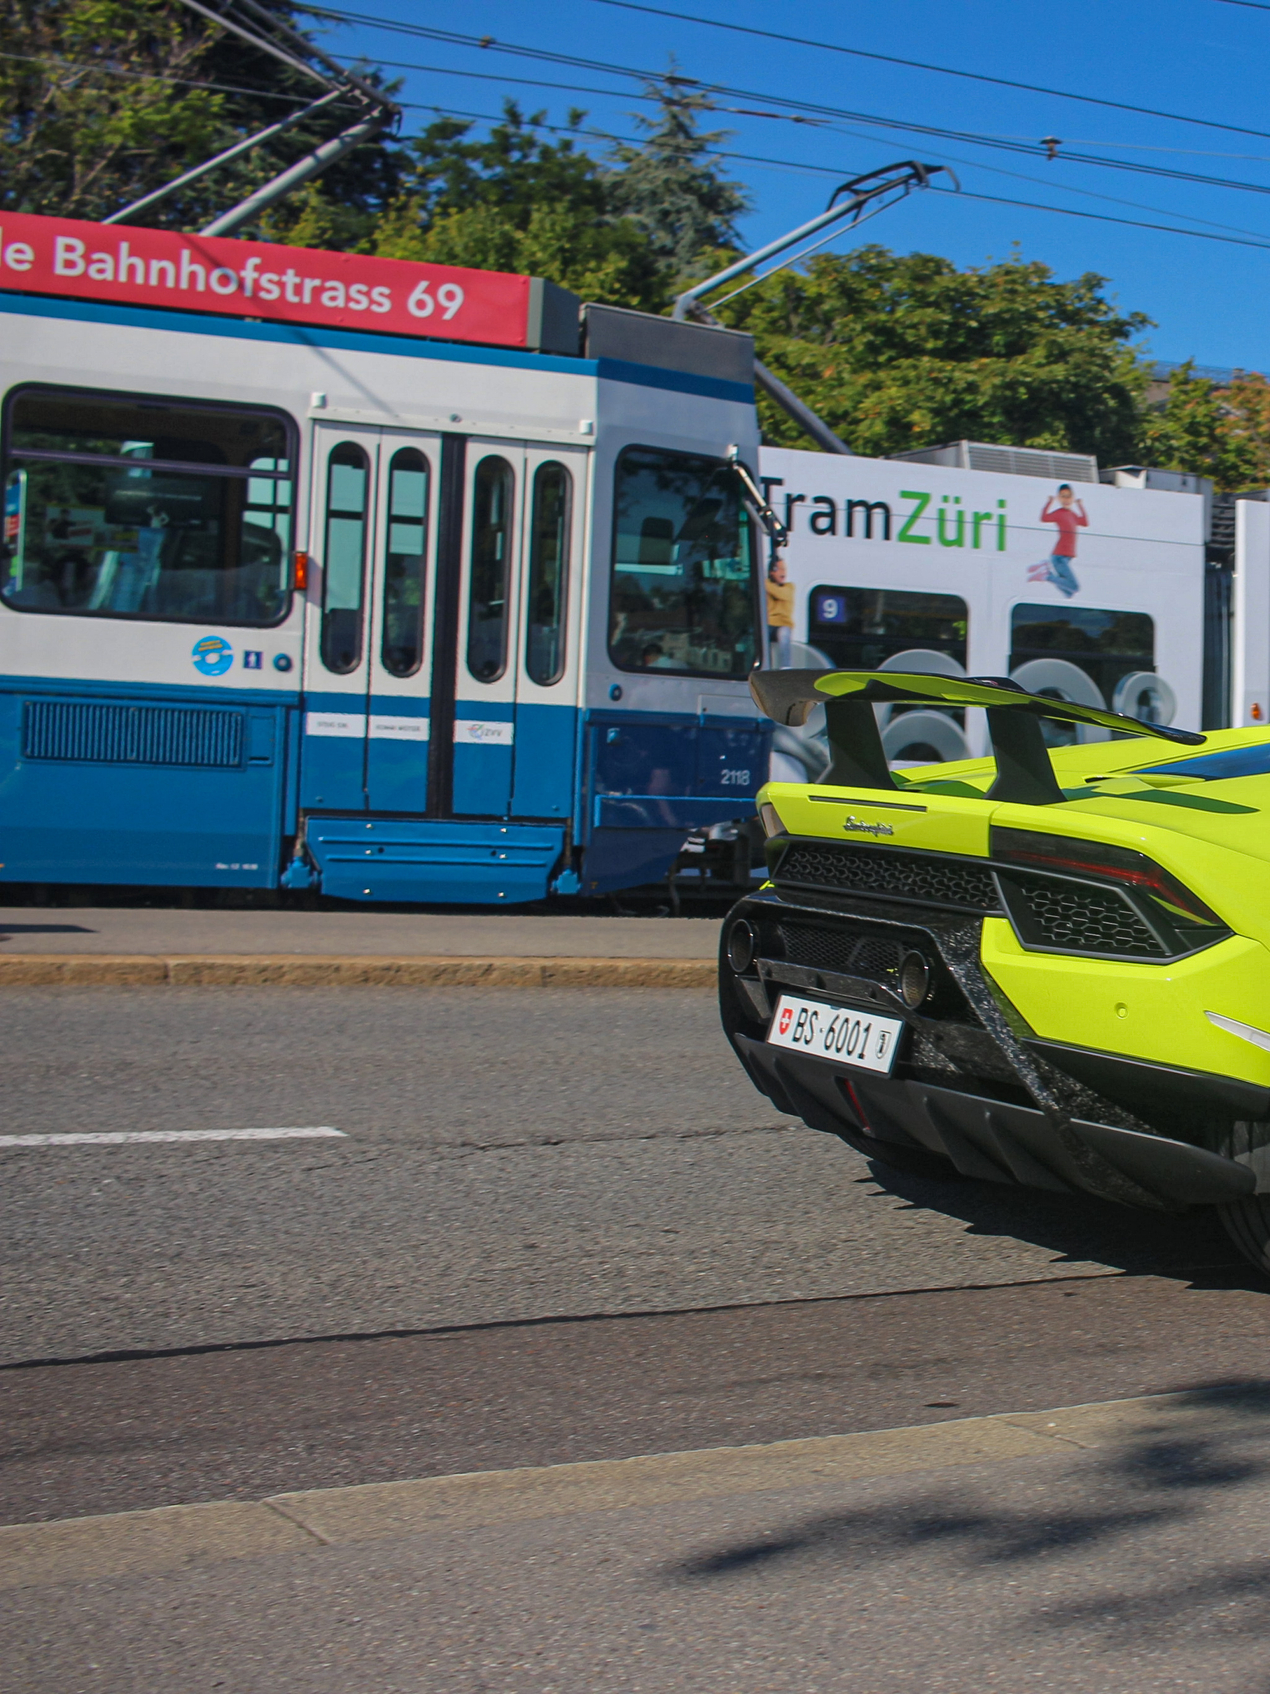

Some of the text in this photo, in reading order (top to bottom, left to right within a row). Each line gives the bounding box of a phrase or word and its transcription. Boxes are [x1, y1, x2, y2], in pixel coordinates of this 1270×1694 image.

[0, 226, 464, 321] e Bahnhofstrass 69
[822, 599, 839, 619] 9
[720, 769, 751, 786] 2118
